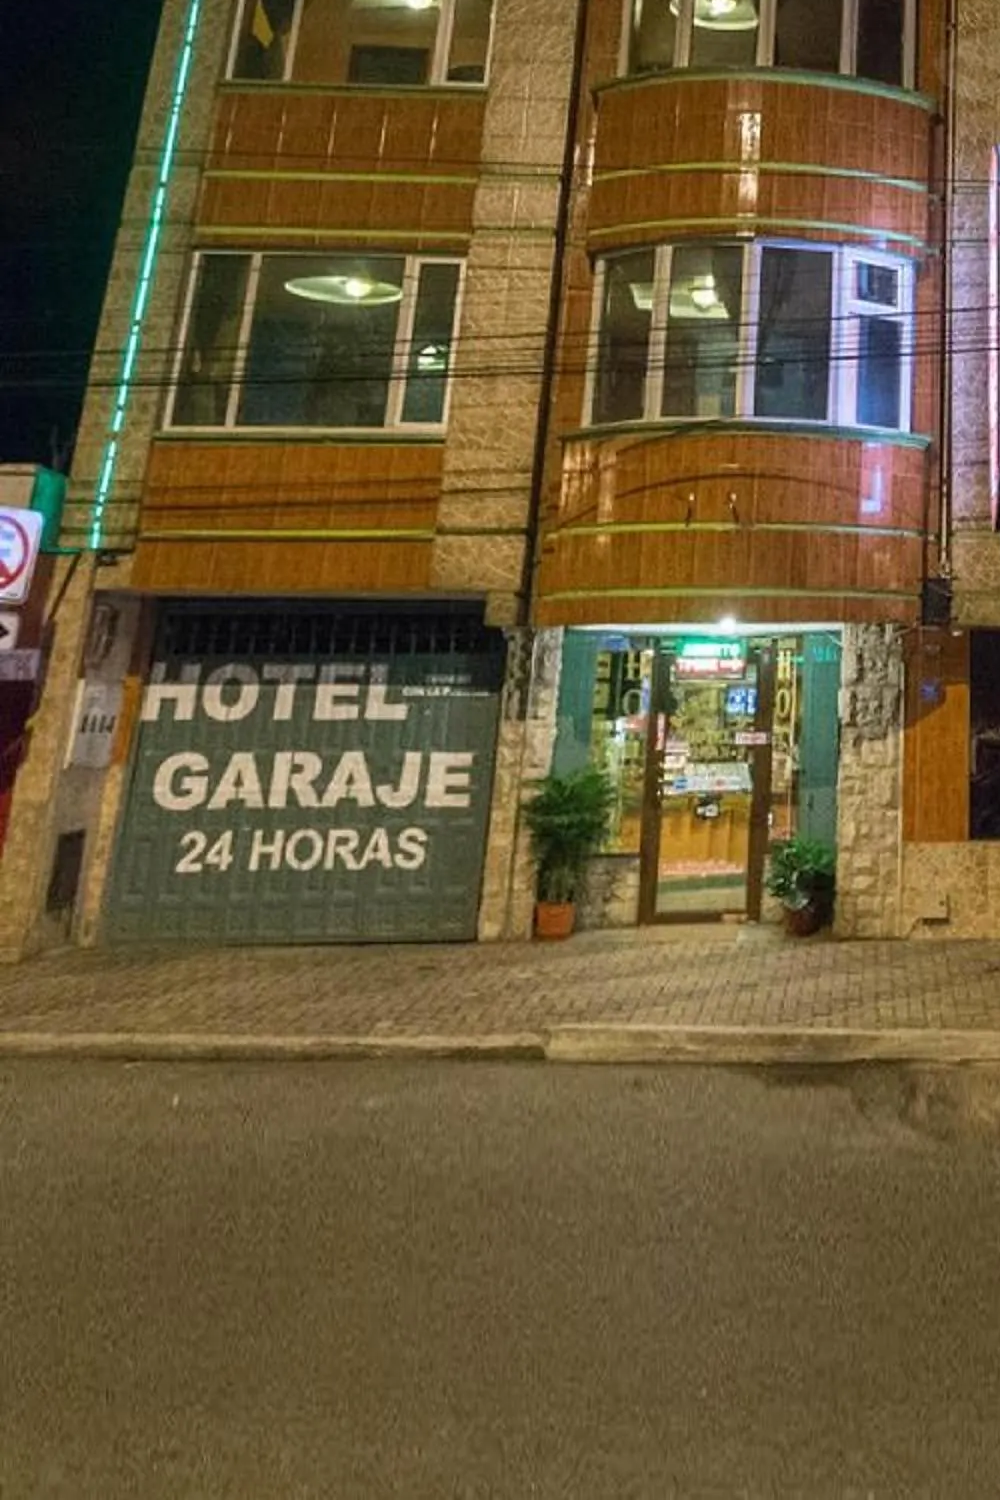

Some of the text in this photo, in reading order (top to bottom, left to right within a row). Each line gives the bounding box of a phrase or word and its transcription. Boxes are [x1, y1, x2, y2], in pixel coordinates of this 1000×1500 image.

[140, 661, 409, 722] HOTEL
[152, 750, 476, 811] GARAJE
[174, 826, 429, 873] 24 HORAS
